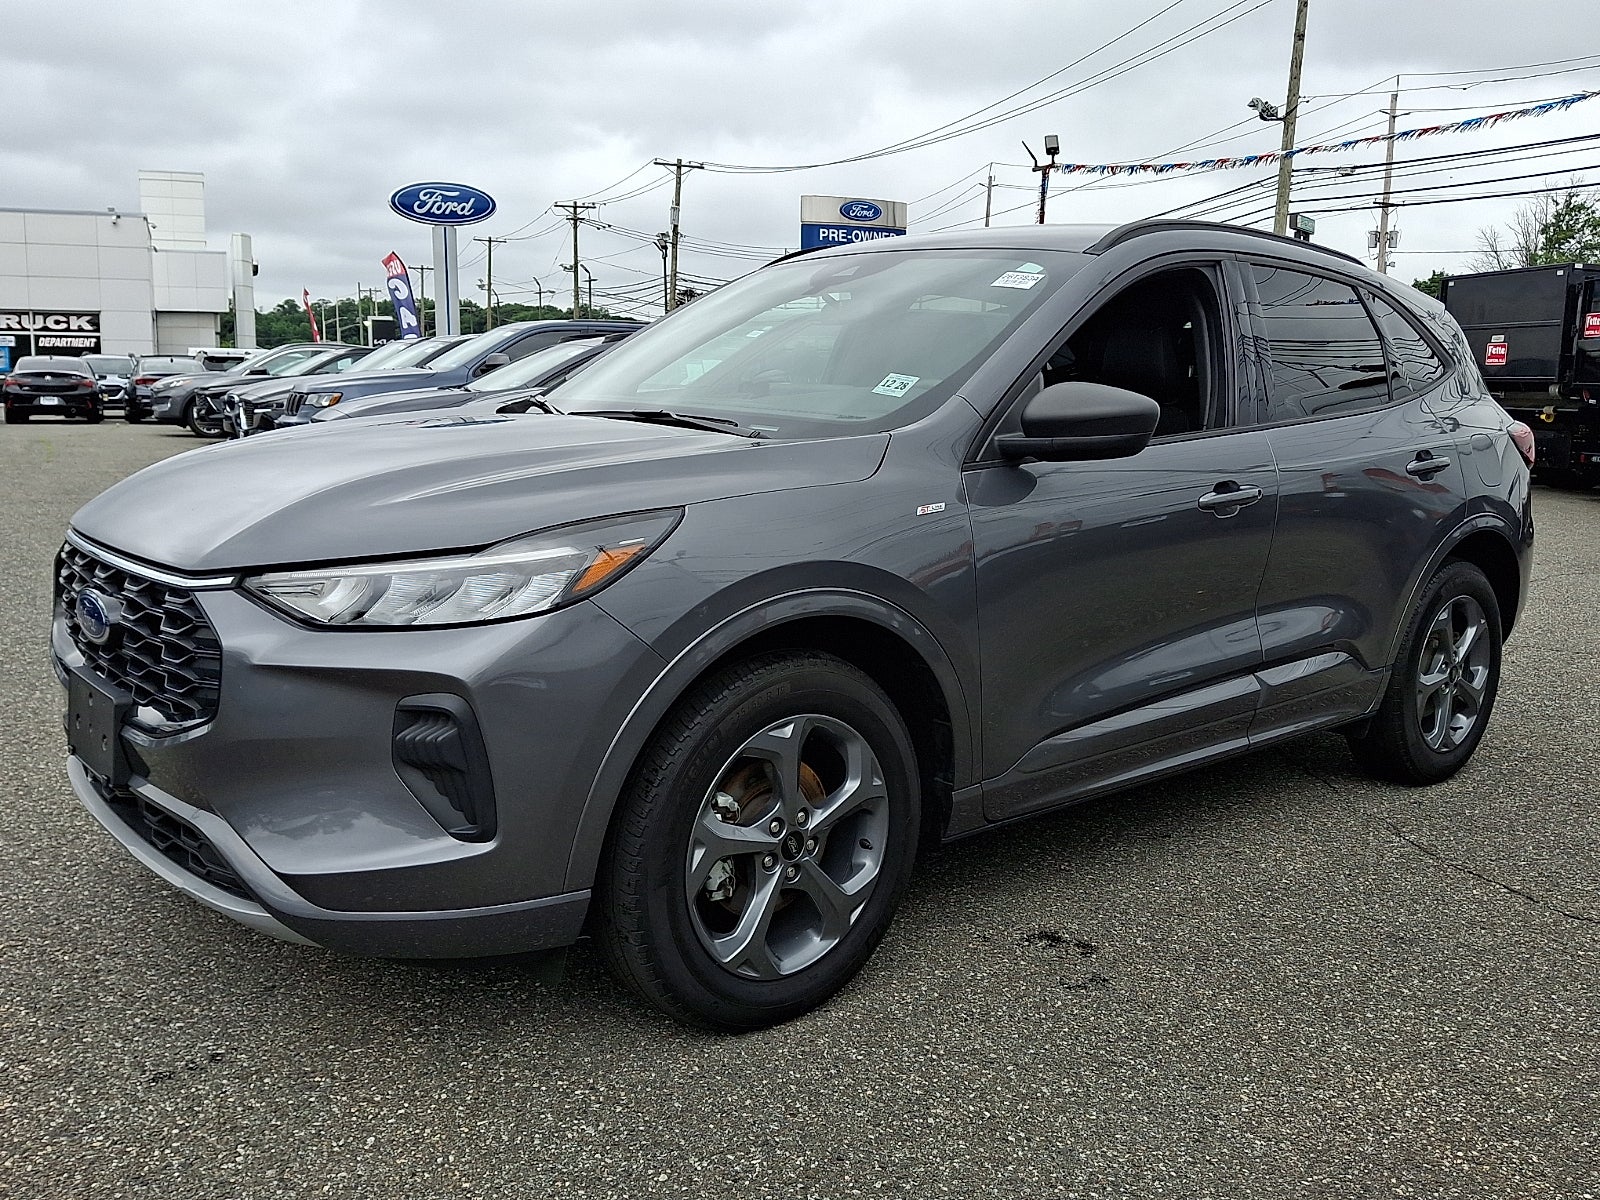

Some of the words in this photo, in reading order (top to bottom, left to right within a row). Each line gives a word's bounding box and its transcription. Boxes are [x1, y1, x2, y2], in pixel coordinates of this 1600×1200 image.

[413, 189, 475, 215] Ford
[849, 204, 875, 218] Ford
[0, 314, 94, 330] RUCK
[38, 336, 97, 348] DEPARTMENT
[881, 379, 897, 388] 12
[894, 381, 909, 391] 28
